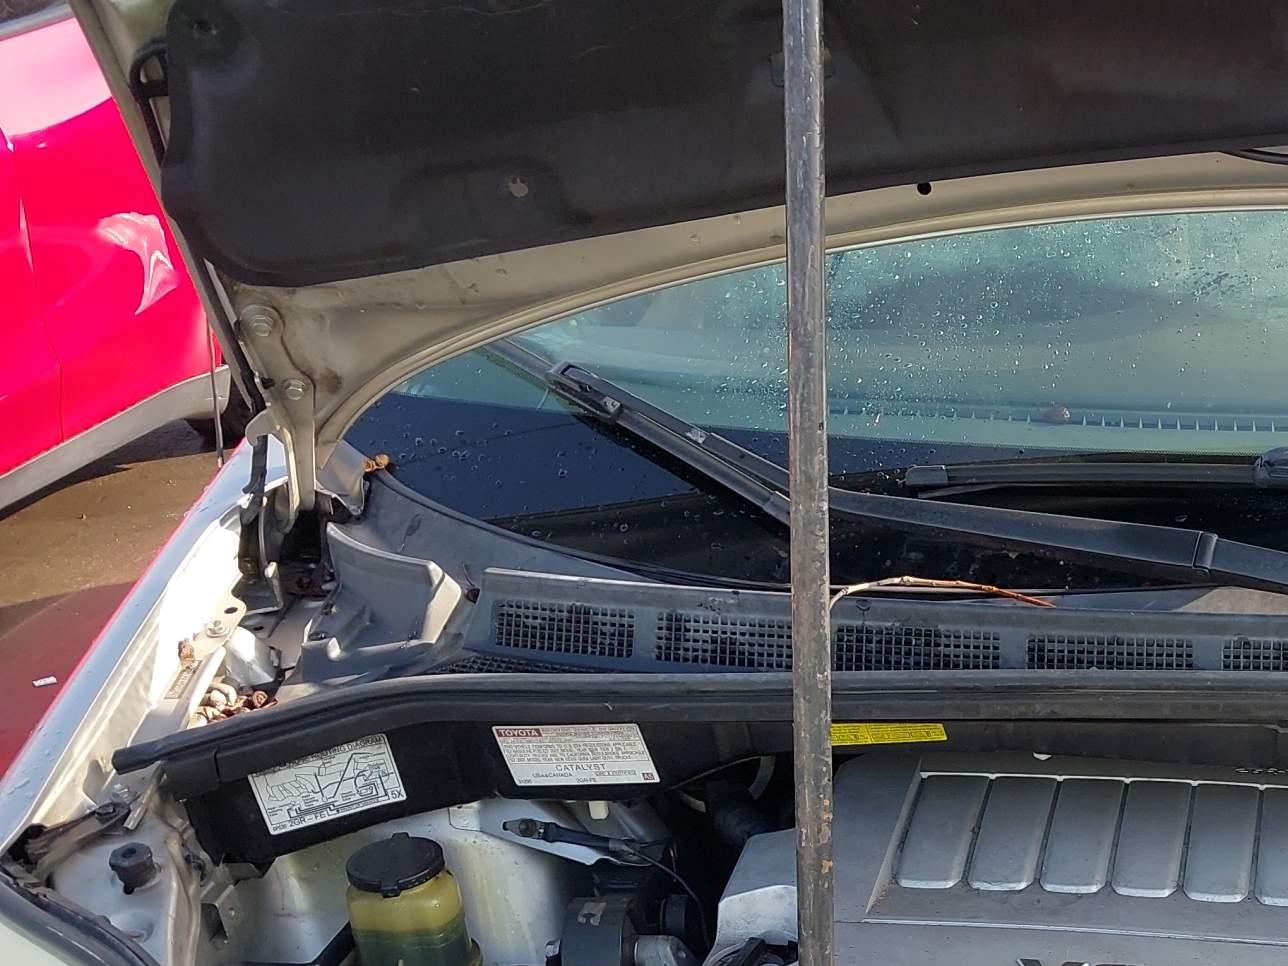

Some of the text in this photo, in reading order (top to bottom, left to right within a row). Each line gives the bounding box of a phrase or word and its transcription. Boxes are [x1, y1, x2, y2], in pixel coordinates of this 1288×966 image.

[499, 729, 539, 737] TOYOTA
[347, 735, 383, 752] DIAGRAM
[555, 763, 607, 771] CATALYST
[391, 789, 405, 801] 5X
